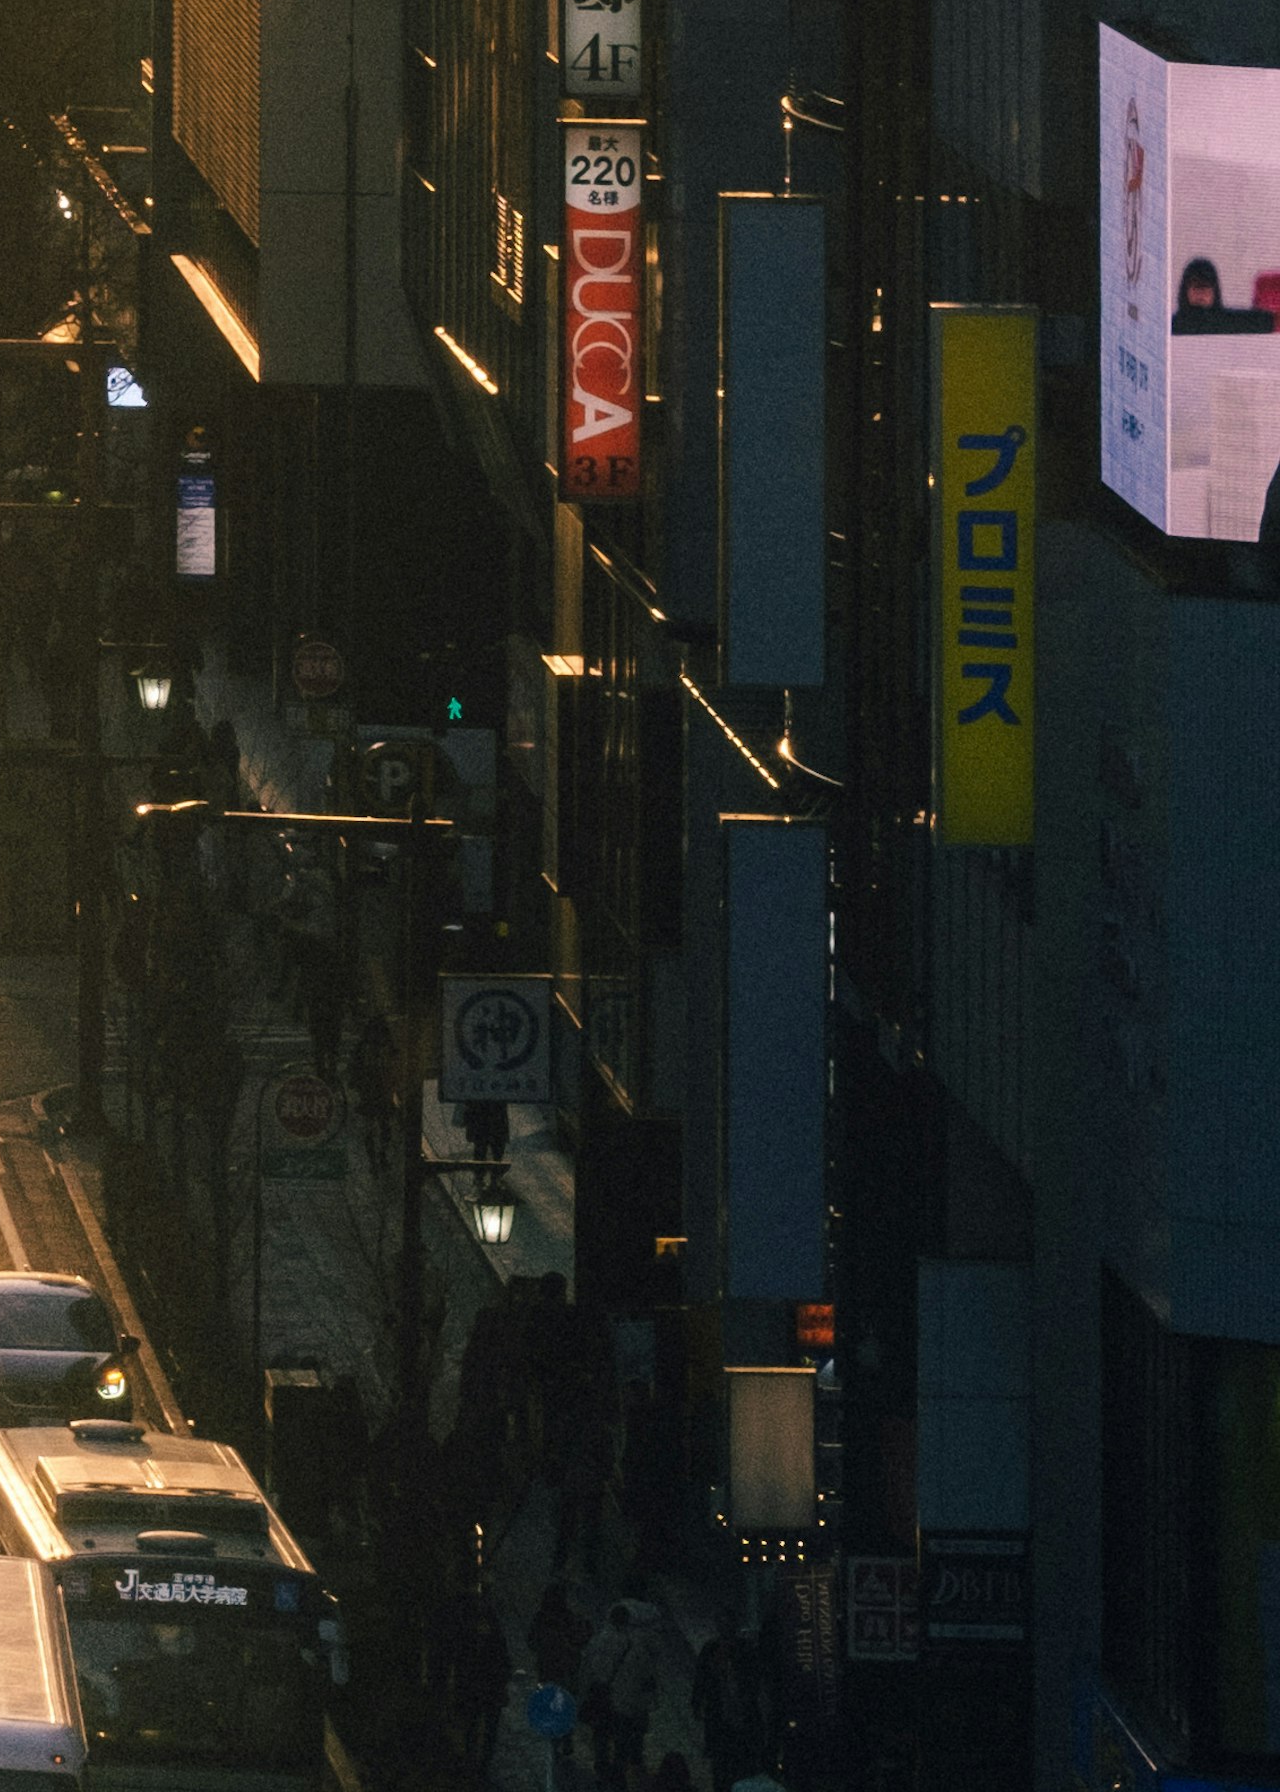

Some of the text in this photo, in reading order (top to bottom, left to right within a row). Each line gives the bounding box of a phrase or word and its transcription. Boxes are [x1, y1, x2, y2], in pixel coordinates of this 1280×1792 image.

[571, 32, 639, 83] 4F
[588, 135, 619, 153] 最大
[571, 155, 637, 187] 220
[588, 189, 619, 207] 名様
[572, 229, 633, 444] DUCCA
[574, 455, 635, 489] 3F
[957, 427, 1027, 728] プロミス
[139, 1582, 248, 1606] 交通局大学病院
